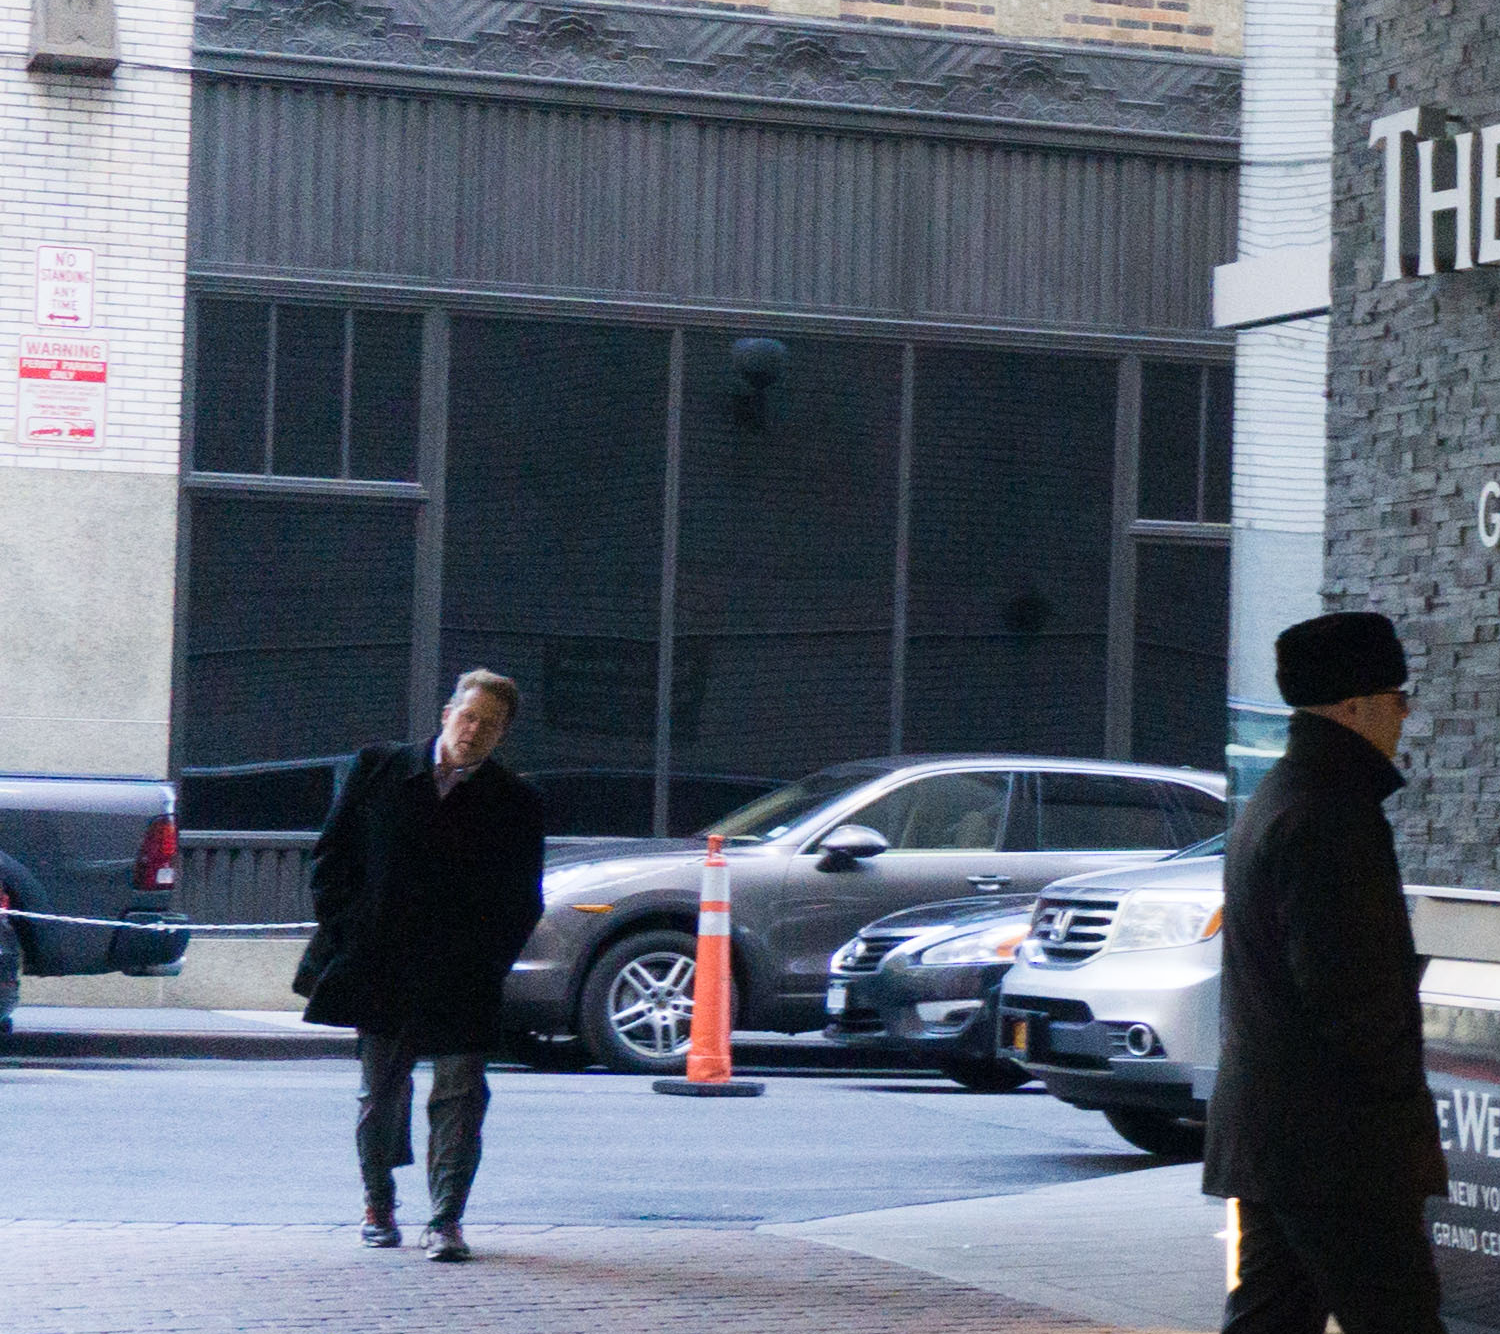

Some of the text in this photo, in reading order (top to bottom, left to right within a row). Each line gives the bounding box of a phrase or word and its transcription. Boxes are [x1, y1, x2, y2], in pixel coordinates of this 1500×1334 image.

[55, 252, 77, 267] NO
[40, 268, 91, 283] STANDING
[26, 342, 101, 359] WARNING
[1449, 1179, 1478, 1207] NEW
[1432, 1221, 1478, 1252] GRAND
